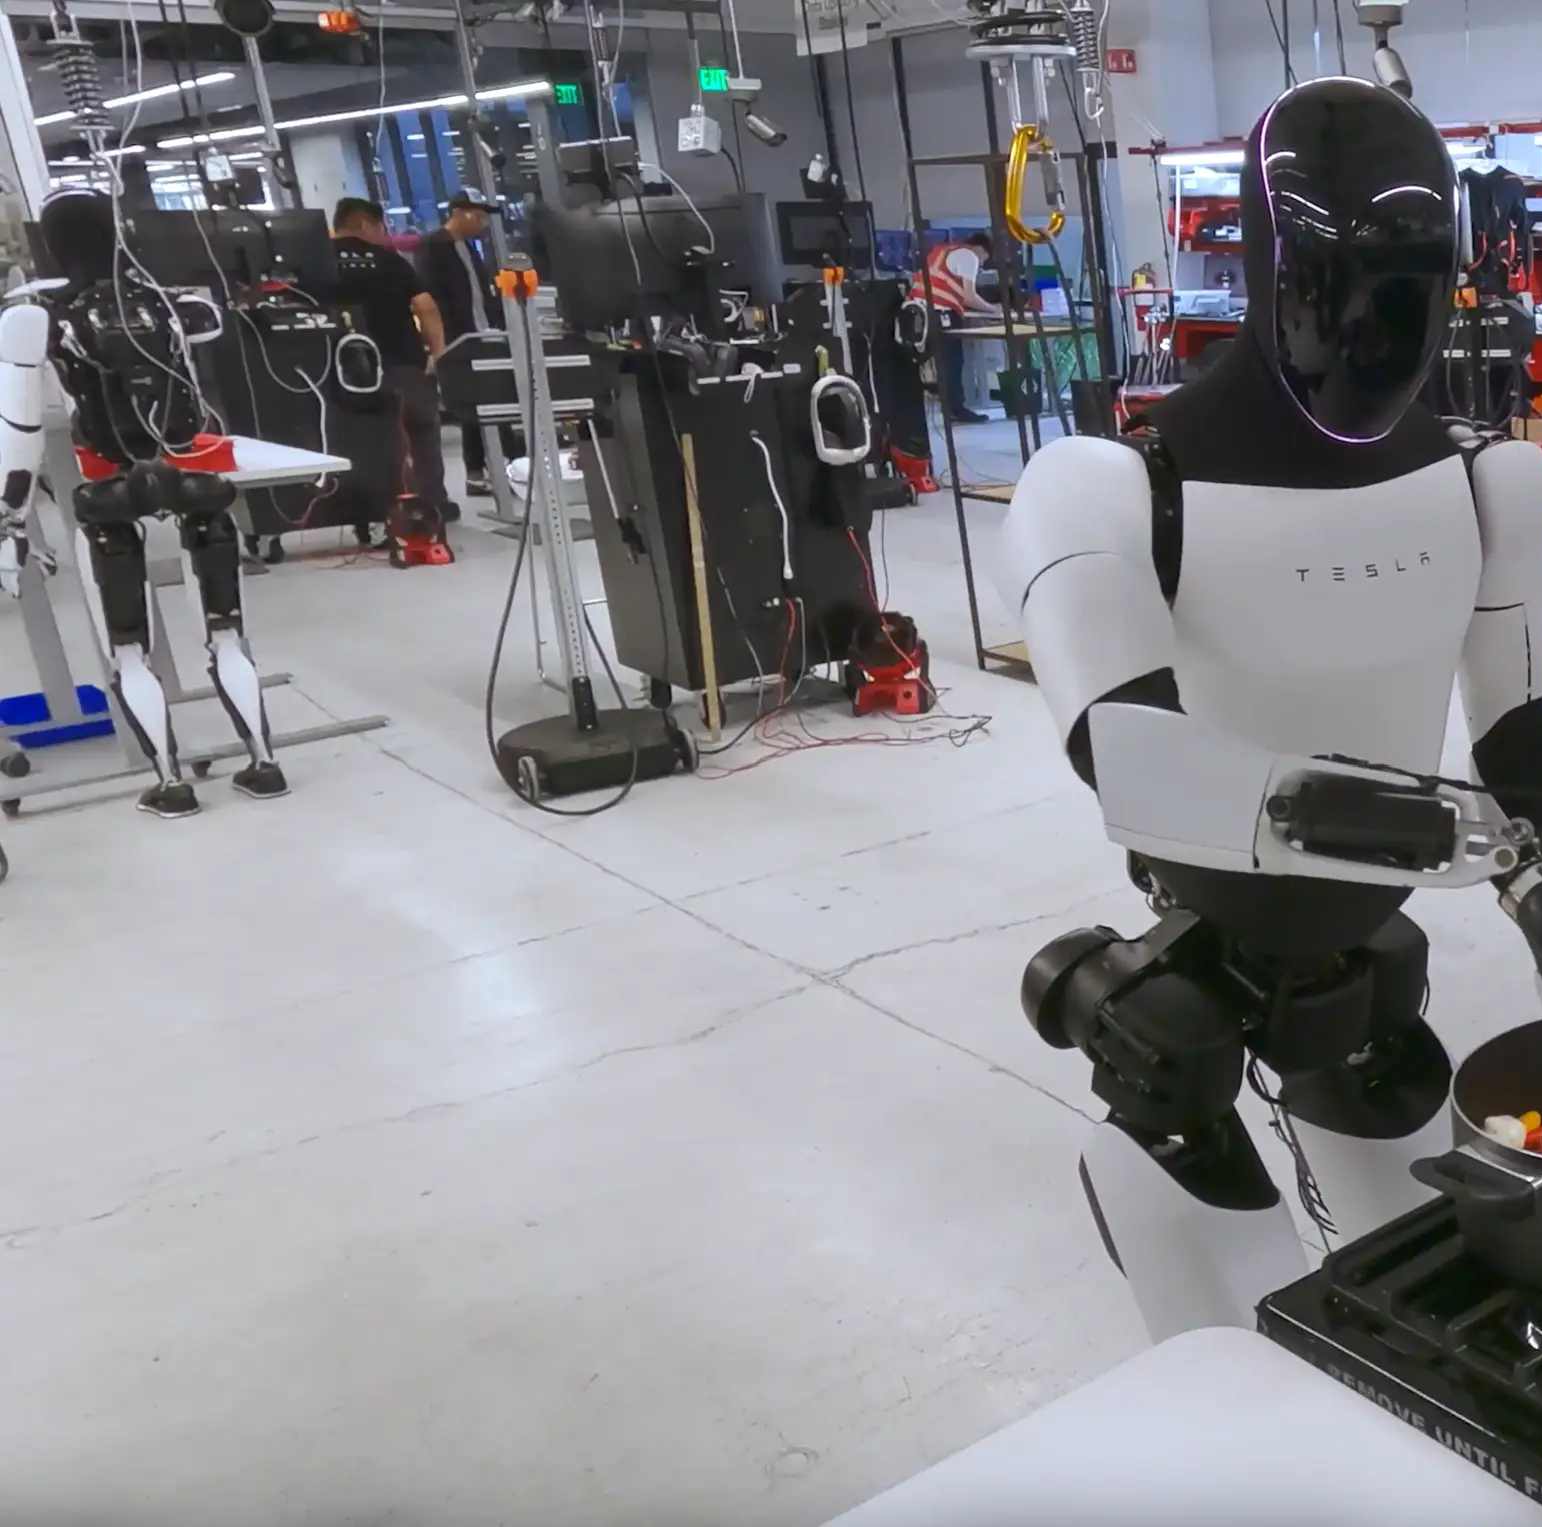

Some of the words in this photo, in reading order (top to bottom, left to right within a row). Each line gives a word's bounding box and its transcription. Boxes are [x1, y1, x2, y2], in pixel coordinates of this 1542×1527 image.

[700, 69, 728, 90] EXIT
[1296, 551, 1431, 582] TESLA
[1435, 1425, 1517, 1486] UNTIL
